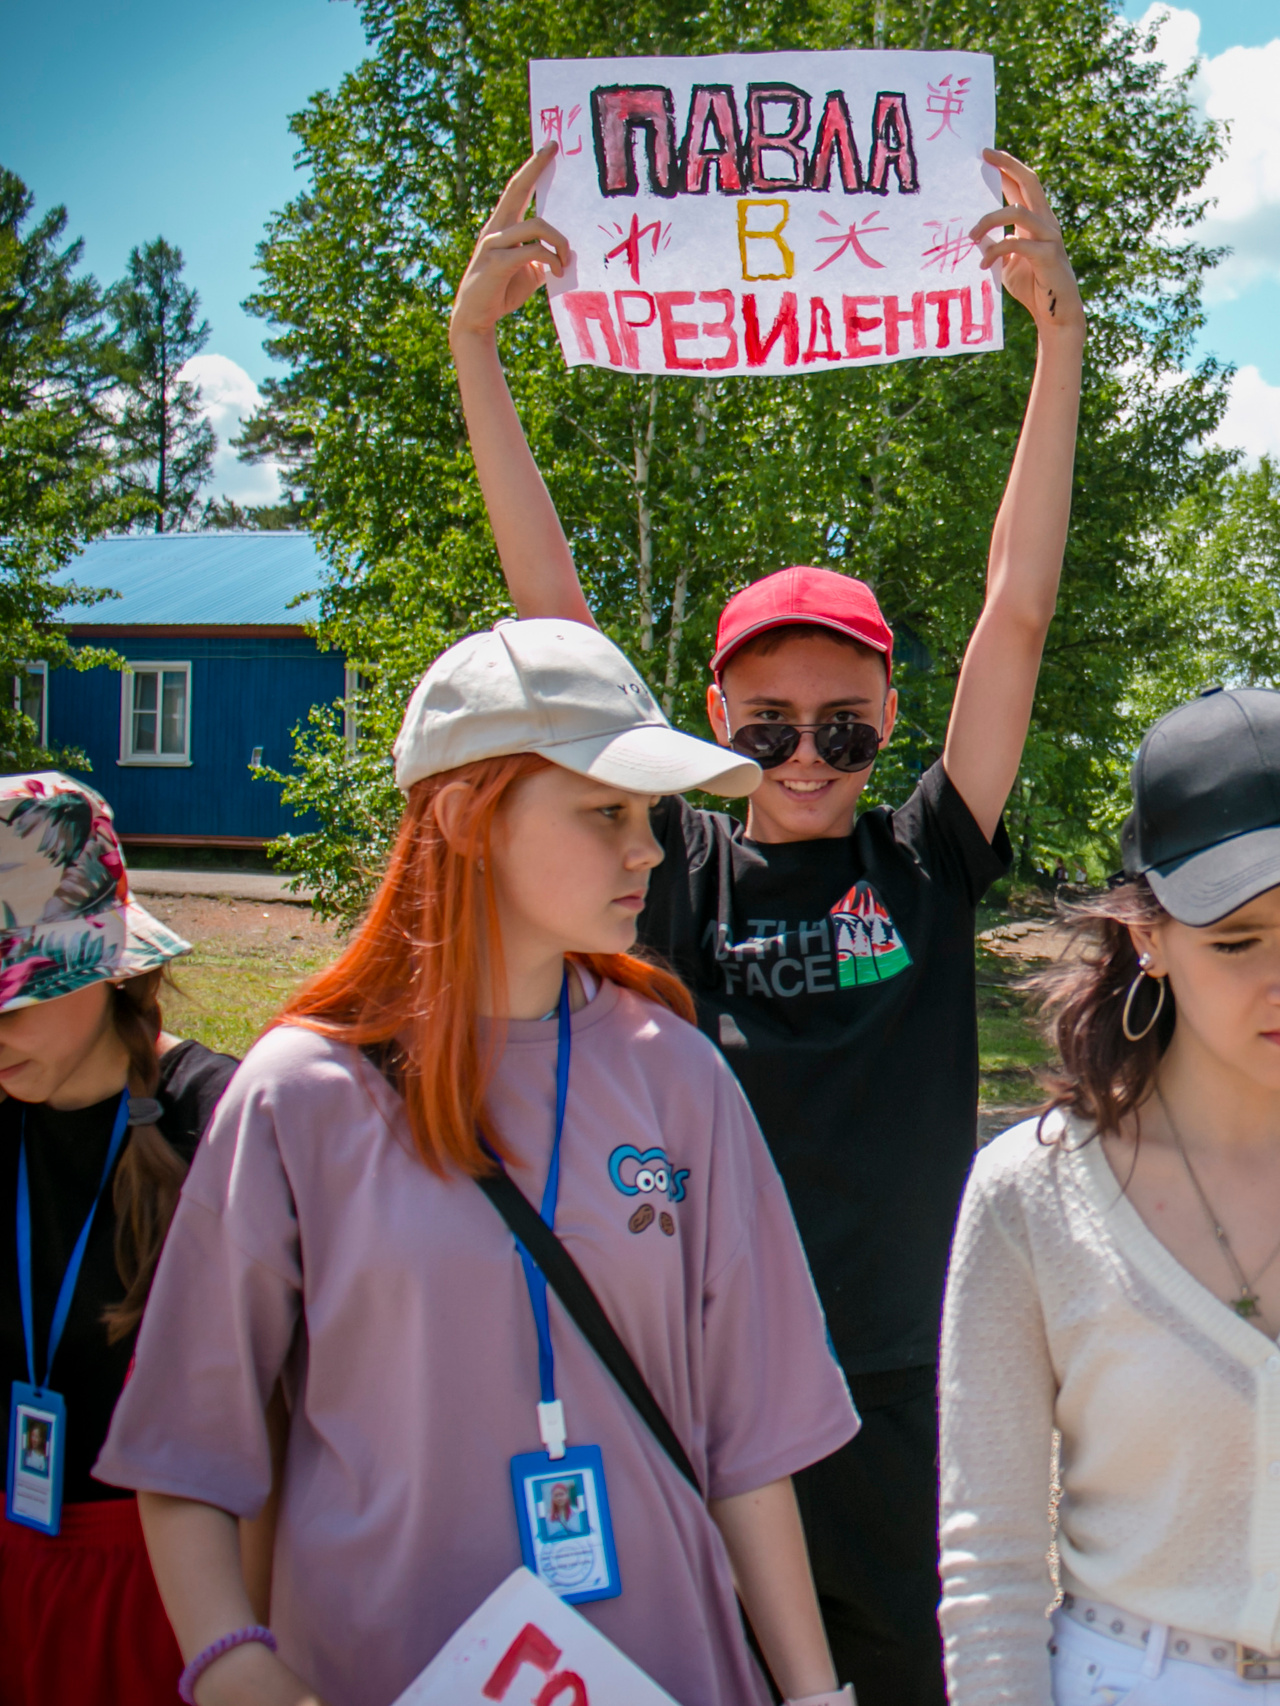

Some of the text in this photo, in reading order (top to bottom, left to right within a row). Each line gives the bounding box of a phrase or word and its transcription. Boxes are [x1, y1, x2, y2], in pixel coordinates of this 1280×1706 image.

[590, 81, 921, 198] ПАВЛА
[737, 199, 794, 282] В
[562, 279, 995, 370] ПРЕЗИДЕНТЫ
[719, 954, 836, 998] FACE
